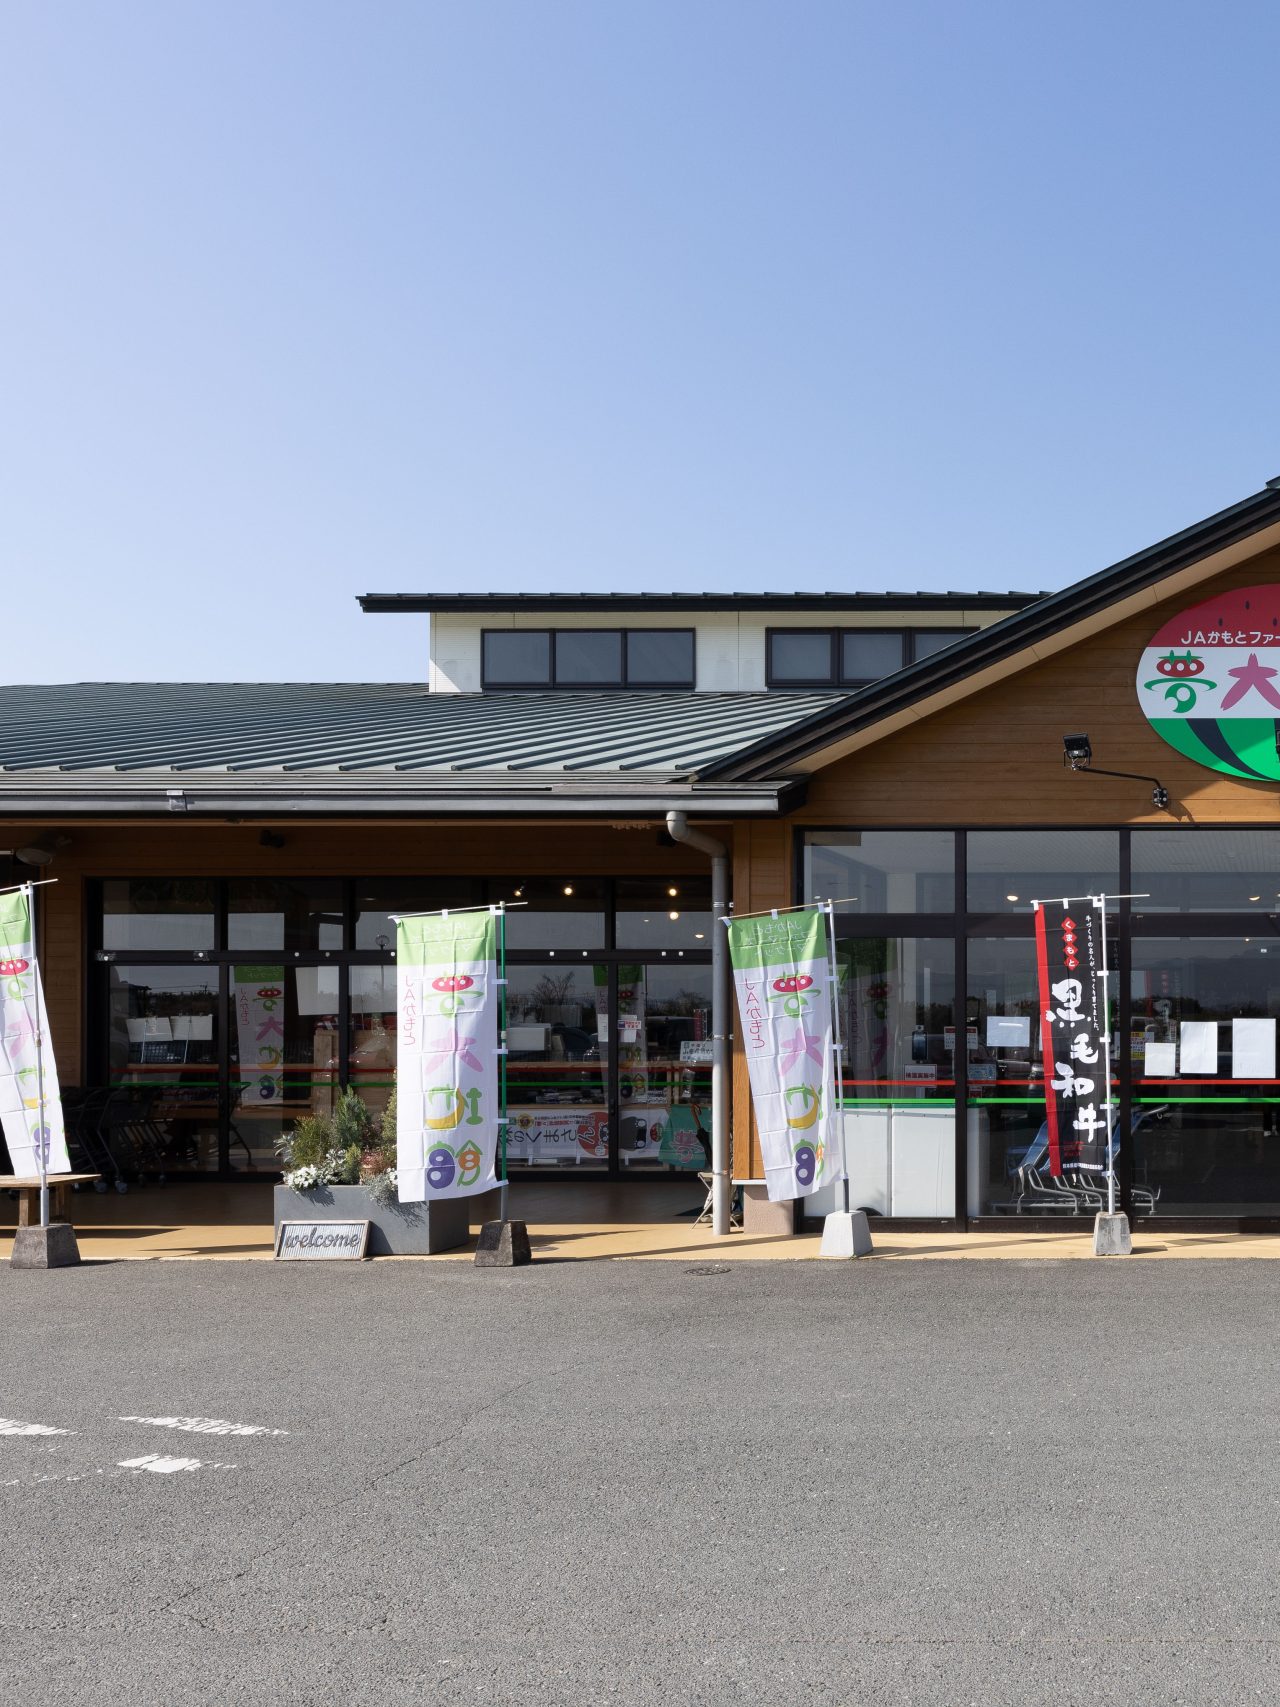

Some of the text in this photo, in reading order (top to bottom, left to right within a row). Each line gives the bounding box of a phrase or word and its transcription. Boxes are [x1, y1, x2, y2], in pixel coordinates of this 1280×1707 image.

[1064, 920, 1076, 968] くまもと
[1045, 978, 1107, 1143] 黒毛和牛
[286, 1227, 361, 1249] welcome
